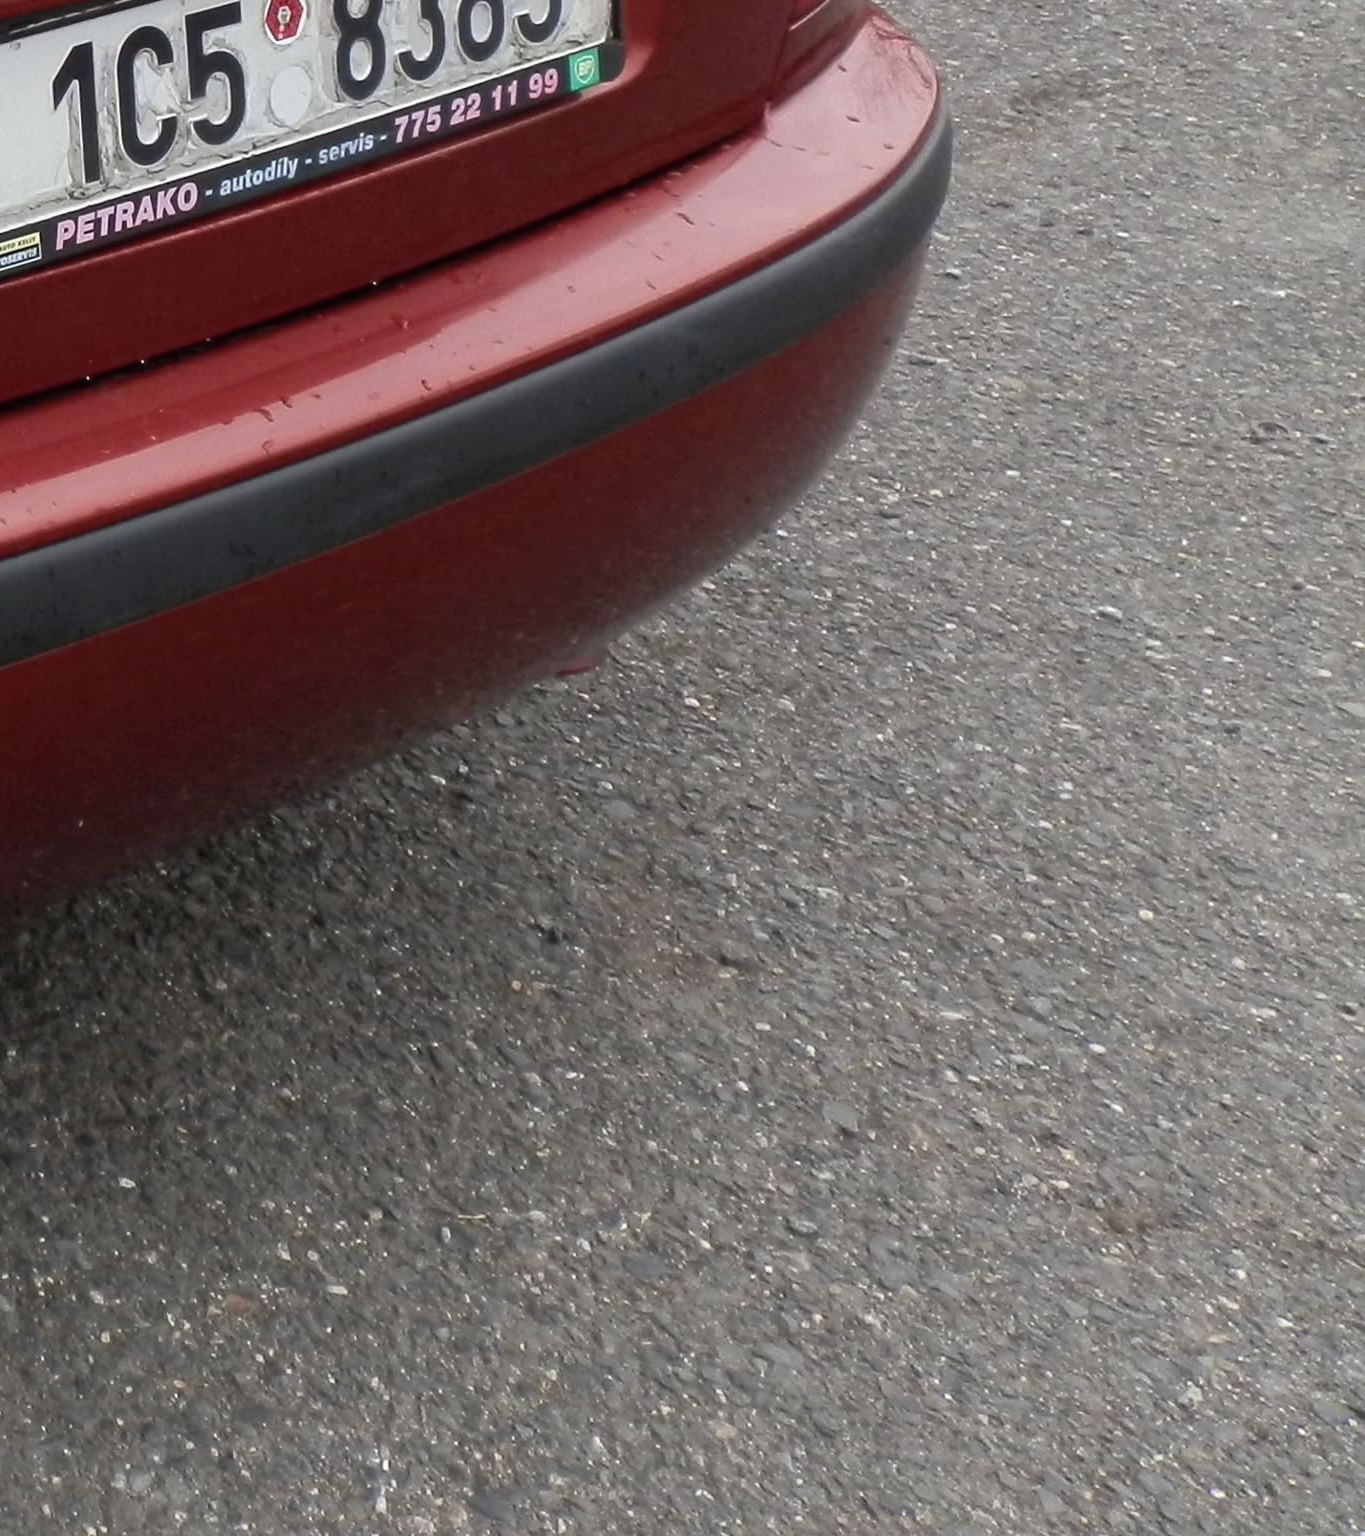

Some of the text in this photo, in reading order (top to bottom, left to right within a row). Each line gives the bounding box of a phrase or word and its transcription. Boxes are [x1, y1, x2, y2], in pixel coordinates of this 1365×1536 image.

[52, 0, 248, 185] 1C5
[56, 181, 199, 250] PETRAKO
[220, 156, 299, 196] autodíly
[318, 132, 374, 164] servis
[395, 104, 442, 144] 775
[449, 92, 481, 126] 22
[491, 79, 518, 111] 11
[528, 68, 559, 99] 99
